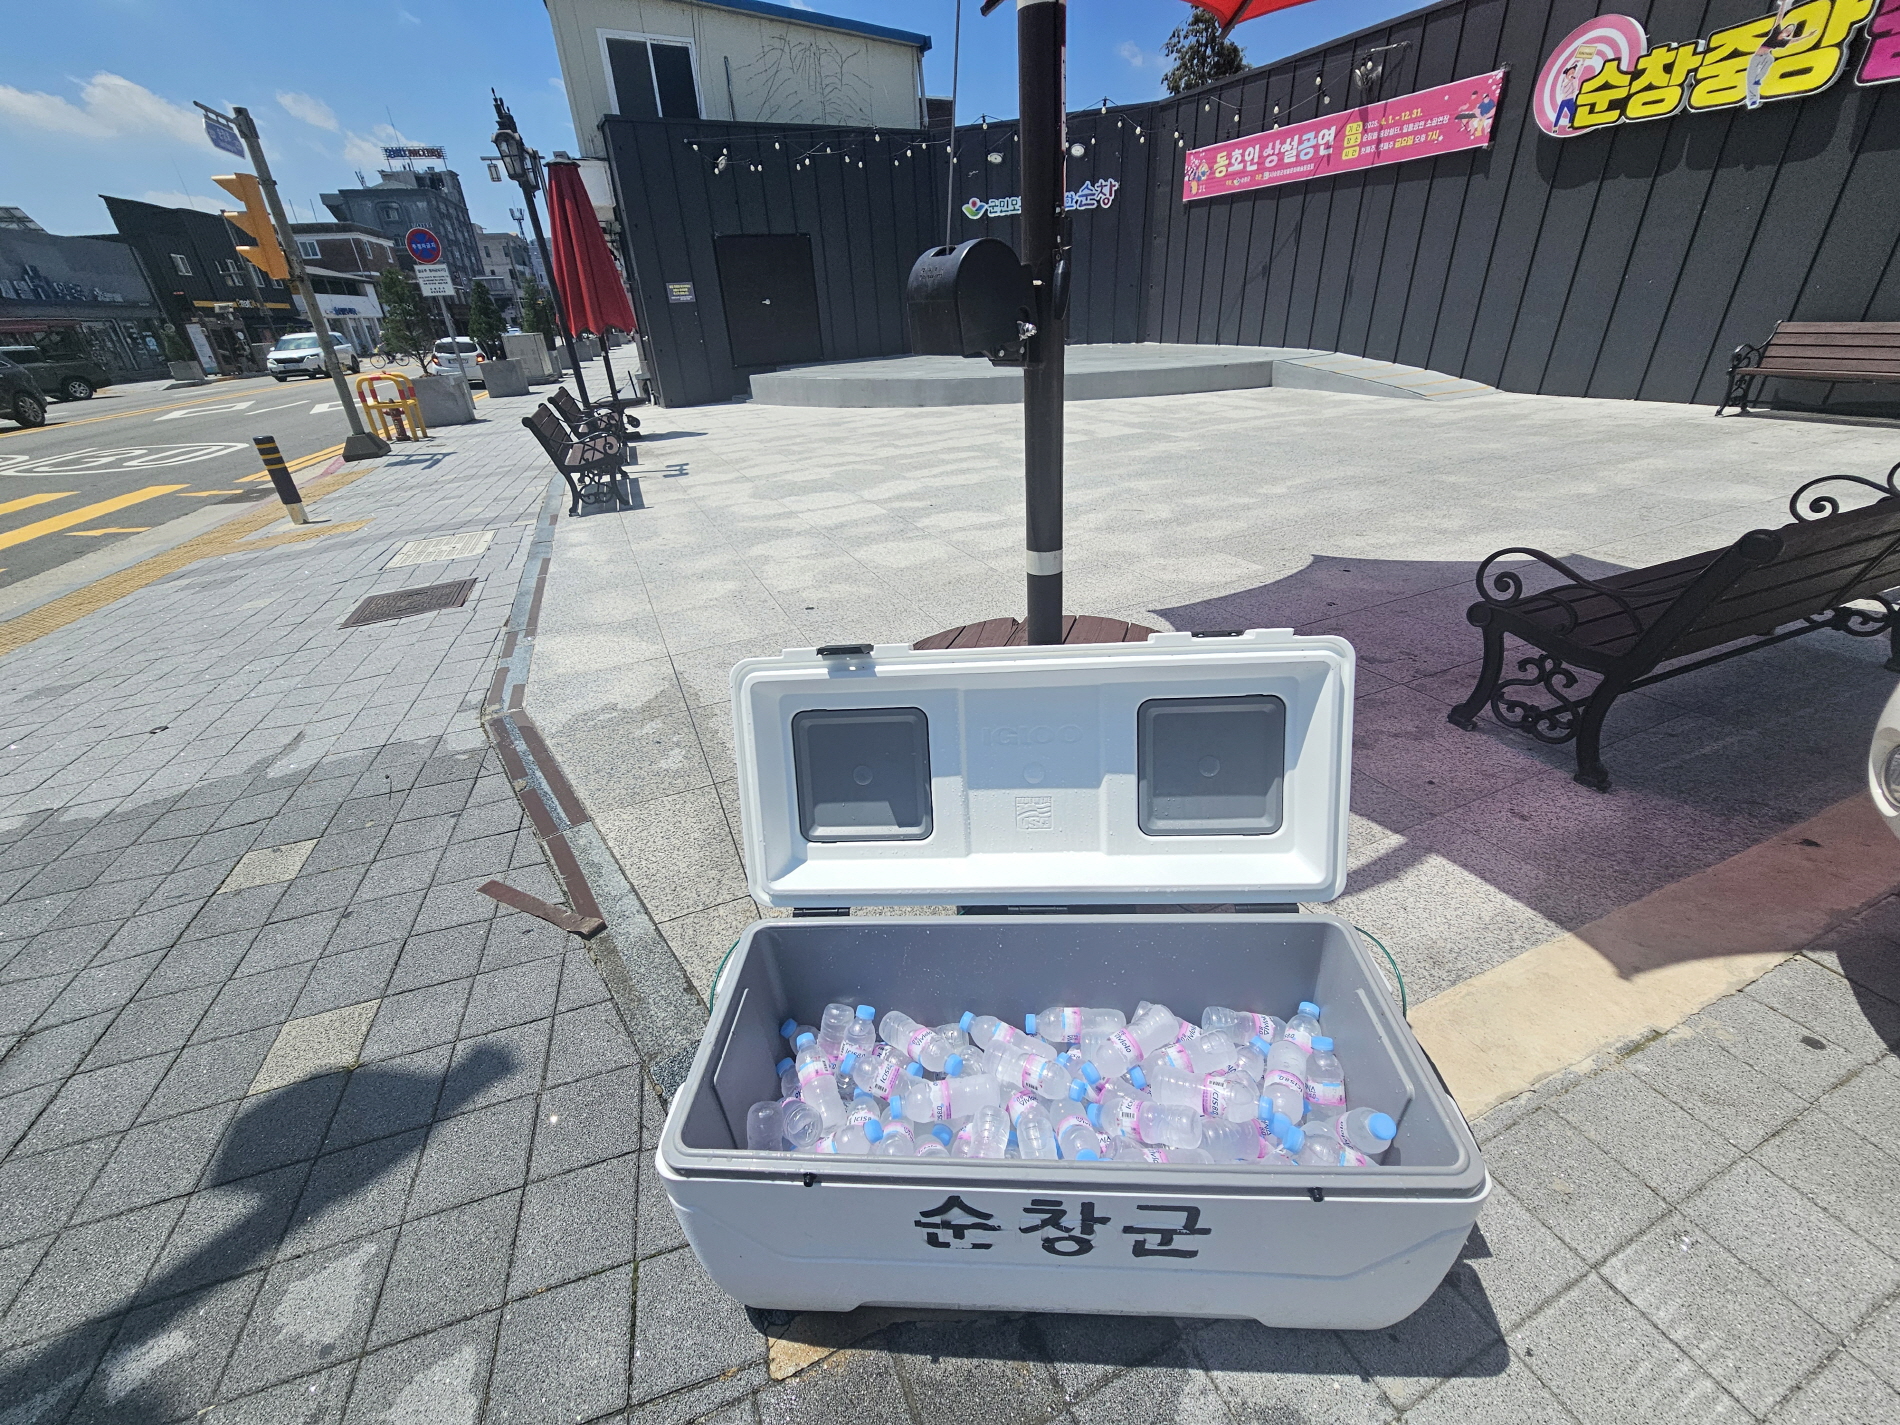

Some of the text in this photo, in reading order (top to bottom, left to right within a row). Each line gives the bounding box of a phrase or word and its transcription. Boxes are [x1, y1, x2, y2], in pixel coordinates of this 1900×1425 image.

[1412, 108, 1422, 118] 31.
[1395, 136, 1414, 148] 금요일
[1414, 134, 1426, 143] 오후
[1427, 130, 1440, 140] 7시
[1213, 125, 1336, 178] 동호인 상설공연
[1078, 179, 1118, 207] 순창
[989, 198, 1021, 214] 군민모
[914, 1195, 1212, 1258] 순창군
